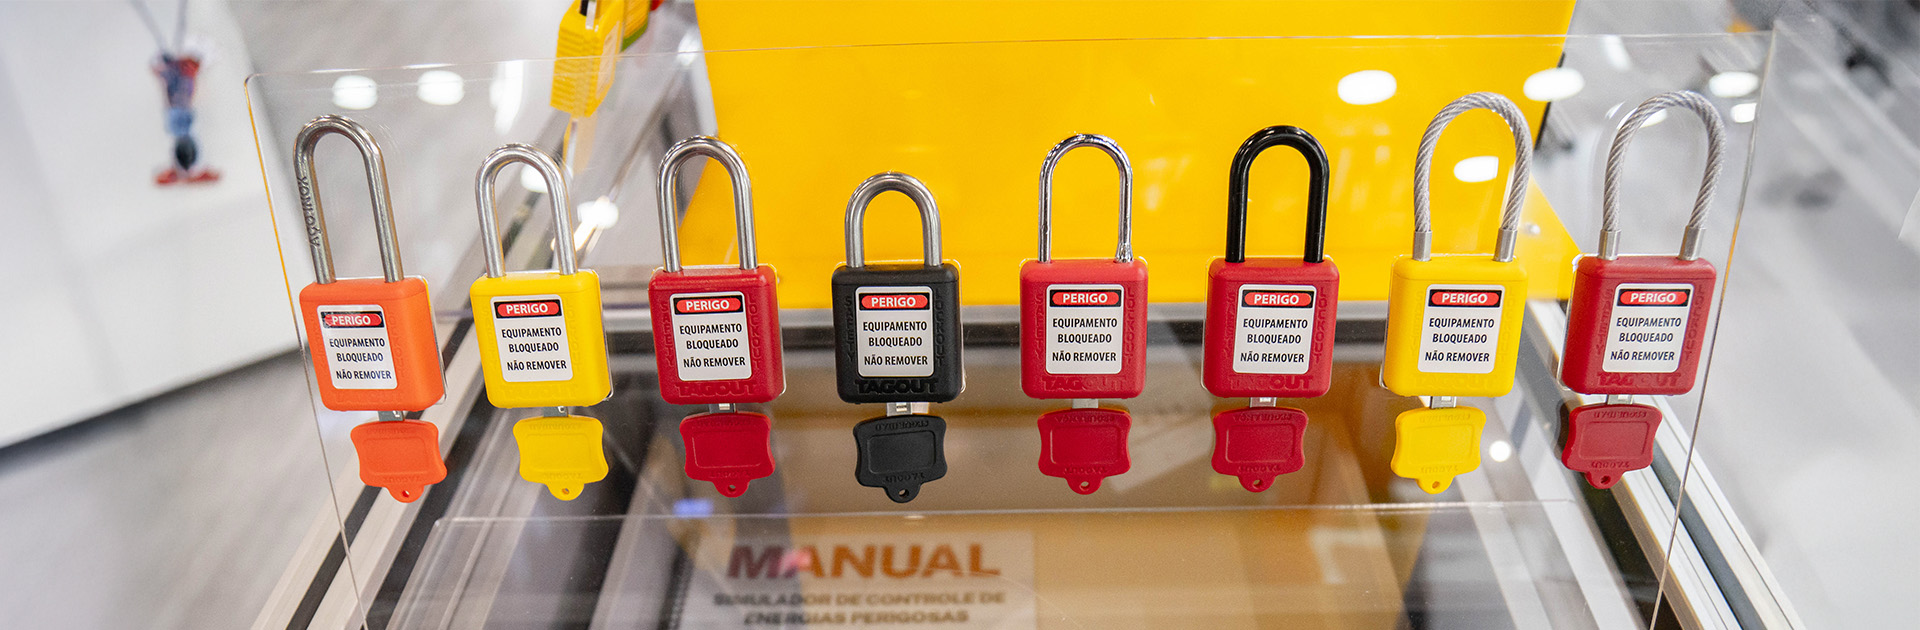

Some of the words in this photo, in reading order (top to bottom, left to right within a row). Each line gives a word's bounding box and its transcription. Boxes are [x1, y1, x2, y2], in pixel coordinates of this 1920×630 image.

[871, 298, 916, 307] PERIGO
[1062, 294, 1108, 303] PERIGO
[1254, 294, 1299, 304] PERIGO
[1442, 294, 1487, 303] PERIGO
[1630, 293, 1676, 303] PERIGO
[506, 304, 548, 314] PERIGO
[686, 300, 729, 311] PERIGO
[332, 316, 371, 325] PERIGO
[1053, 319, 1117, 328] EQUIPAMENTO
[1243, 319, 1308, 328] EQUIPAMENTO
[1313, 287, 1326, 364] LOCKOUT
[1429, 318, 1494, 327] EQUIPAMENTO
[1617, 318, 1681, 327] EQUIPAMENTO
[1682, 284, 1705, 362] LOCKOUT
[680, 324, 742, 334] EQUIPAMENTO
[863, 322, 927, 331] EQUIPAMENTO
[935, 289, 945, 366] LOCKOUT
[502, 328, 562, 338] EQUIPAMENTO
[659, 303, 676, 367] SAFETY
[1619, 333, 1673, 342] BLOQUEADO
[329, 338, 385, 347] EQUIPAMENTO
[868, 337, 922, 346] BLOQUEADO
[1058, 334, 1111, 343] BLOQUEADO
[1247, 334, 1301, 343] BLOQUEADO
[1433, 334, 1487, 343] BLOQUEADO
[508, 343, 559, 353] BLOQUEADO
[686, 339, 738, 349] BLOQUEADO
[337, 353, 383, 362] BLOQUEADO
[864, 354, 882, 365] NÃO
[885, 356, 927, 365] REMOVER
[1052, 351, 1072, 361] NÃO
[1073, 353, 1116, 361] REMOVER
[1240, 352, 1259, 362] NÃO
[1261, 353, 1304, 362] REMOVER
[1425, 351, 1444, 361] NÃO
[1446, 353, 1489, 361] REMOVER
[1611, 350, 1630, 360] NÃO
[1632, 351, 1674, 360] REMOVER
[507, 360, 524, 370] NÃO
[527, 360, 567, 369] REMOVER
[683, 357, 701, 367] NÃO
[704, 357, 745, 367] REMOVER
[336, 369, 352, 379] NÃO
[354, 371, 392, 379] REMOVER
[675, 381, 757, 397] TAGOUT
[854, 379, 939, 394] TAGOUT
[727, 543, 1001, 578] MANUAL
